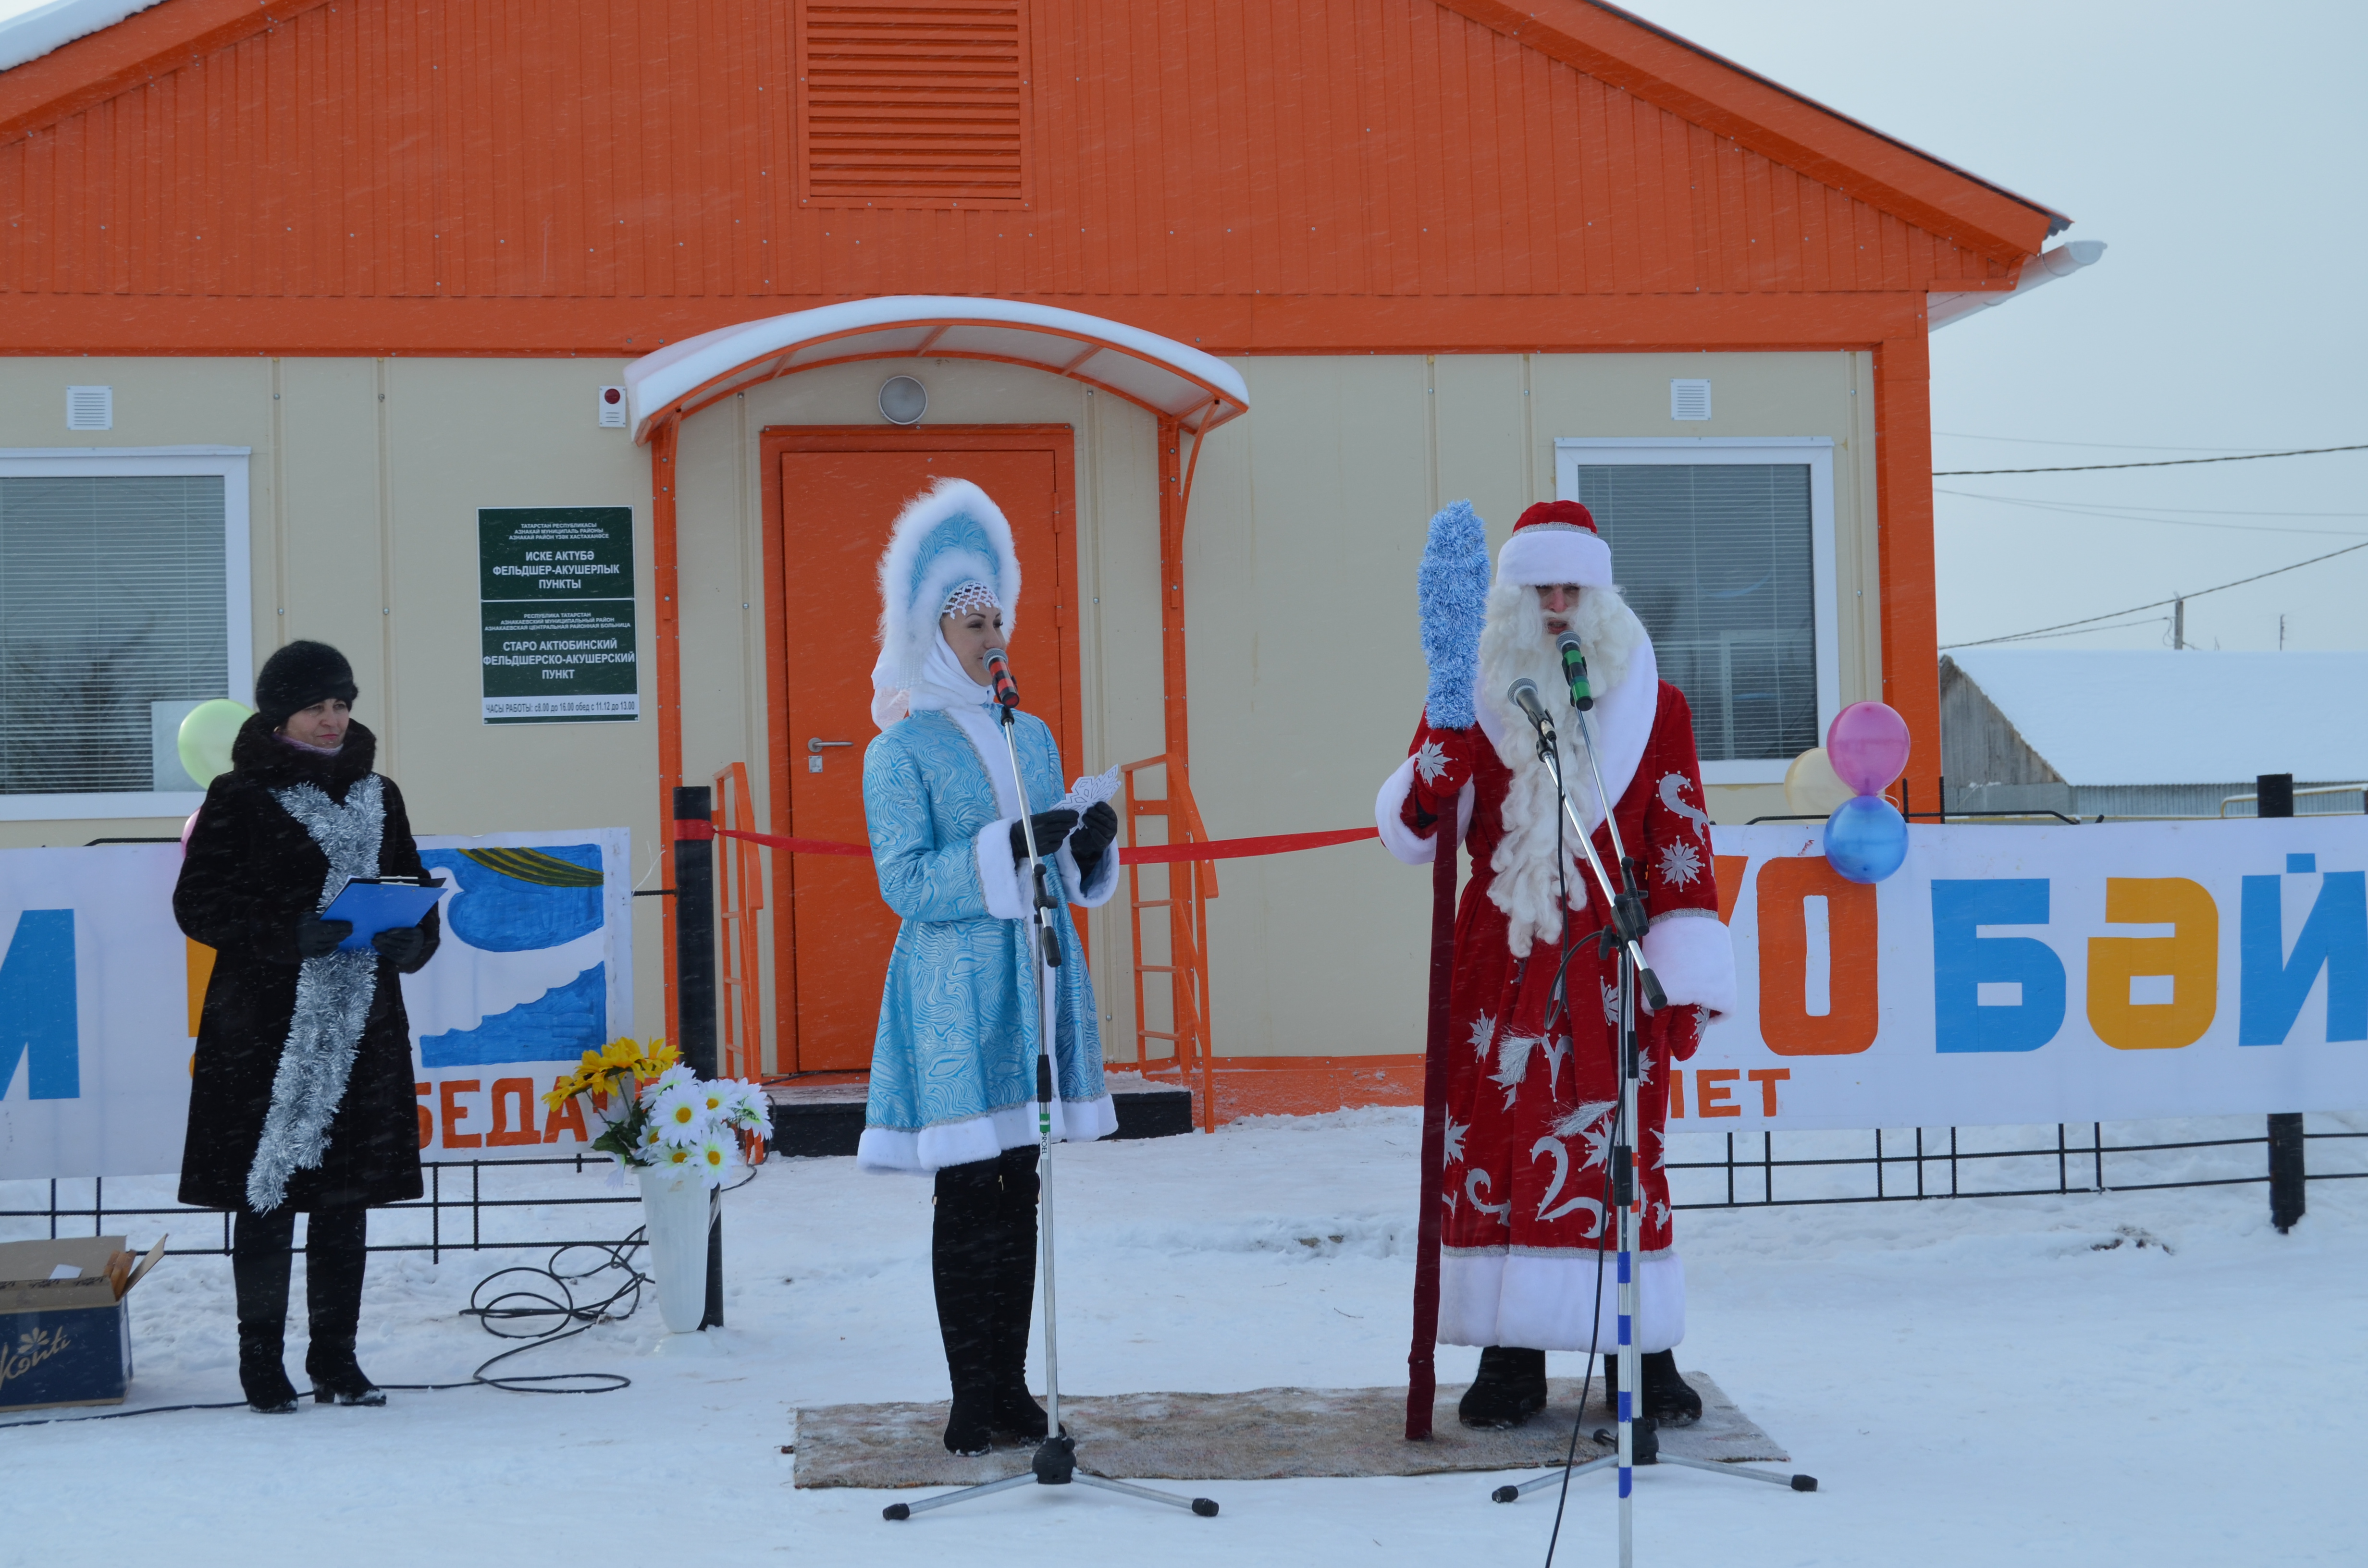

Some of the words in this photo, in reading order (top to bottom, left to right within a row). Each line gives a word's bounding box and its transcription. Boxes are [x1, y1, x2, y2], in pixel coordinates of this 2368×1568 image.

[525, 551, 553, 561] ИСКЕ
[555, 551, 595, 561] АКТҮБӘ
[493, 564, 620, 576] ФЕЛЬДШЕР-АКУШЕРЛЫК
[539, 579, 581, 589] ПУНКТЫ
[503, 641, 537, 651] СТАРО
[540, 637, 617, 650] АКТЮБИНСКИЙ
[483, 651, 635, 667] ФЕЛЬДШЕРСКО-АКУШЕРСКИЙ
[542, 669, 575, 679] ПУНКТ
[486, 704, 505, 713] ЧАСЫ
[506, 703, 533, 713] РАБОТЫ:
[560, 702, 574, 711] 16.00
[575, 702, 590, 712] обед
[596, 701, 610, 711] 11.12
[611, 703, 619, 712] до
[620, 701, 635, 710] 13.00
